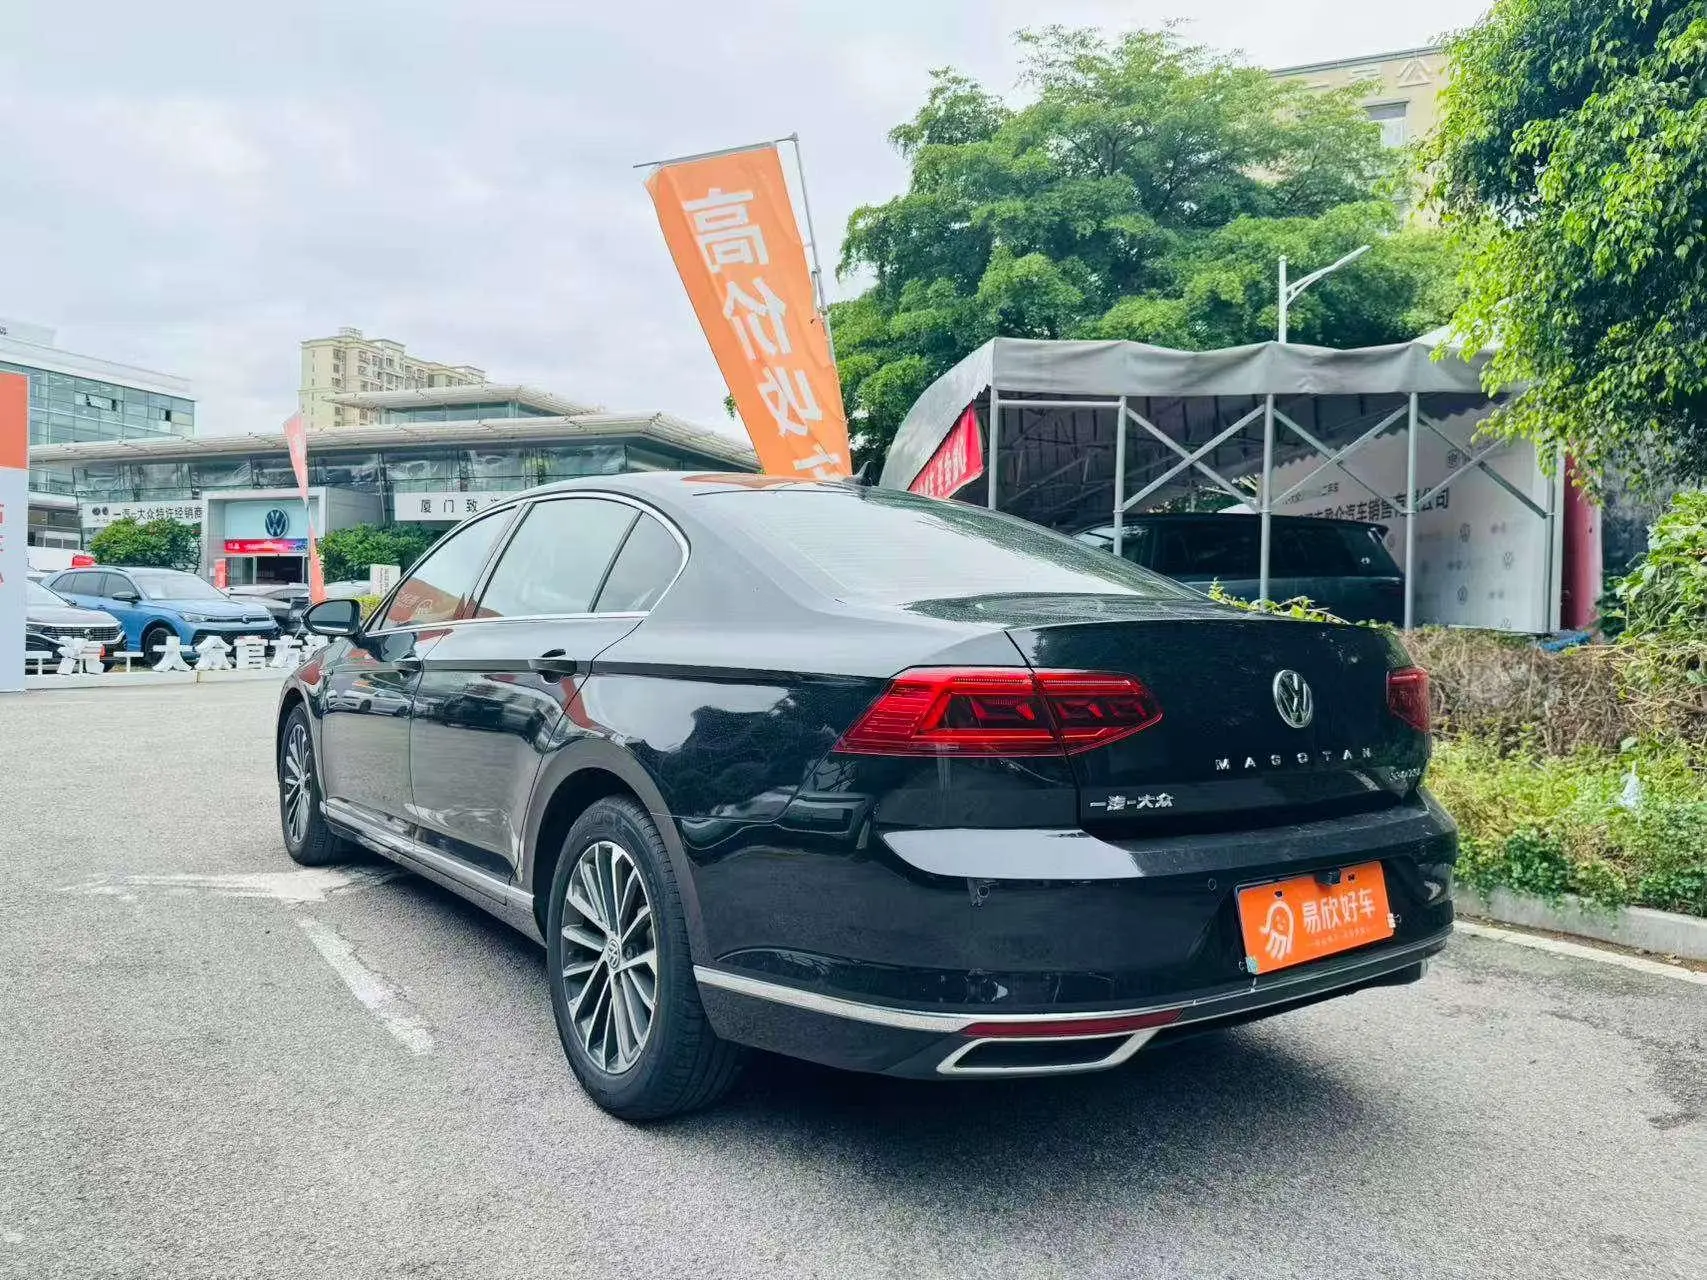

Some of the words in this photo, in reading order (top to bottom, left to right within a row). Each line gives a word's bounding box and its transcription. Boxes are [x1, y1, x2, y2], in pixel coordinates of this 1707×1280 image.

[421, 498, 500, 513] 厦门致
[1215, 747, 1373, 771] MAGOTAN
[1301, 888, 1376, 934] 易欣好车
